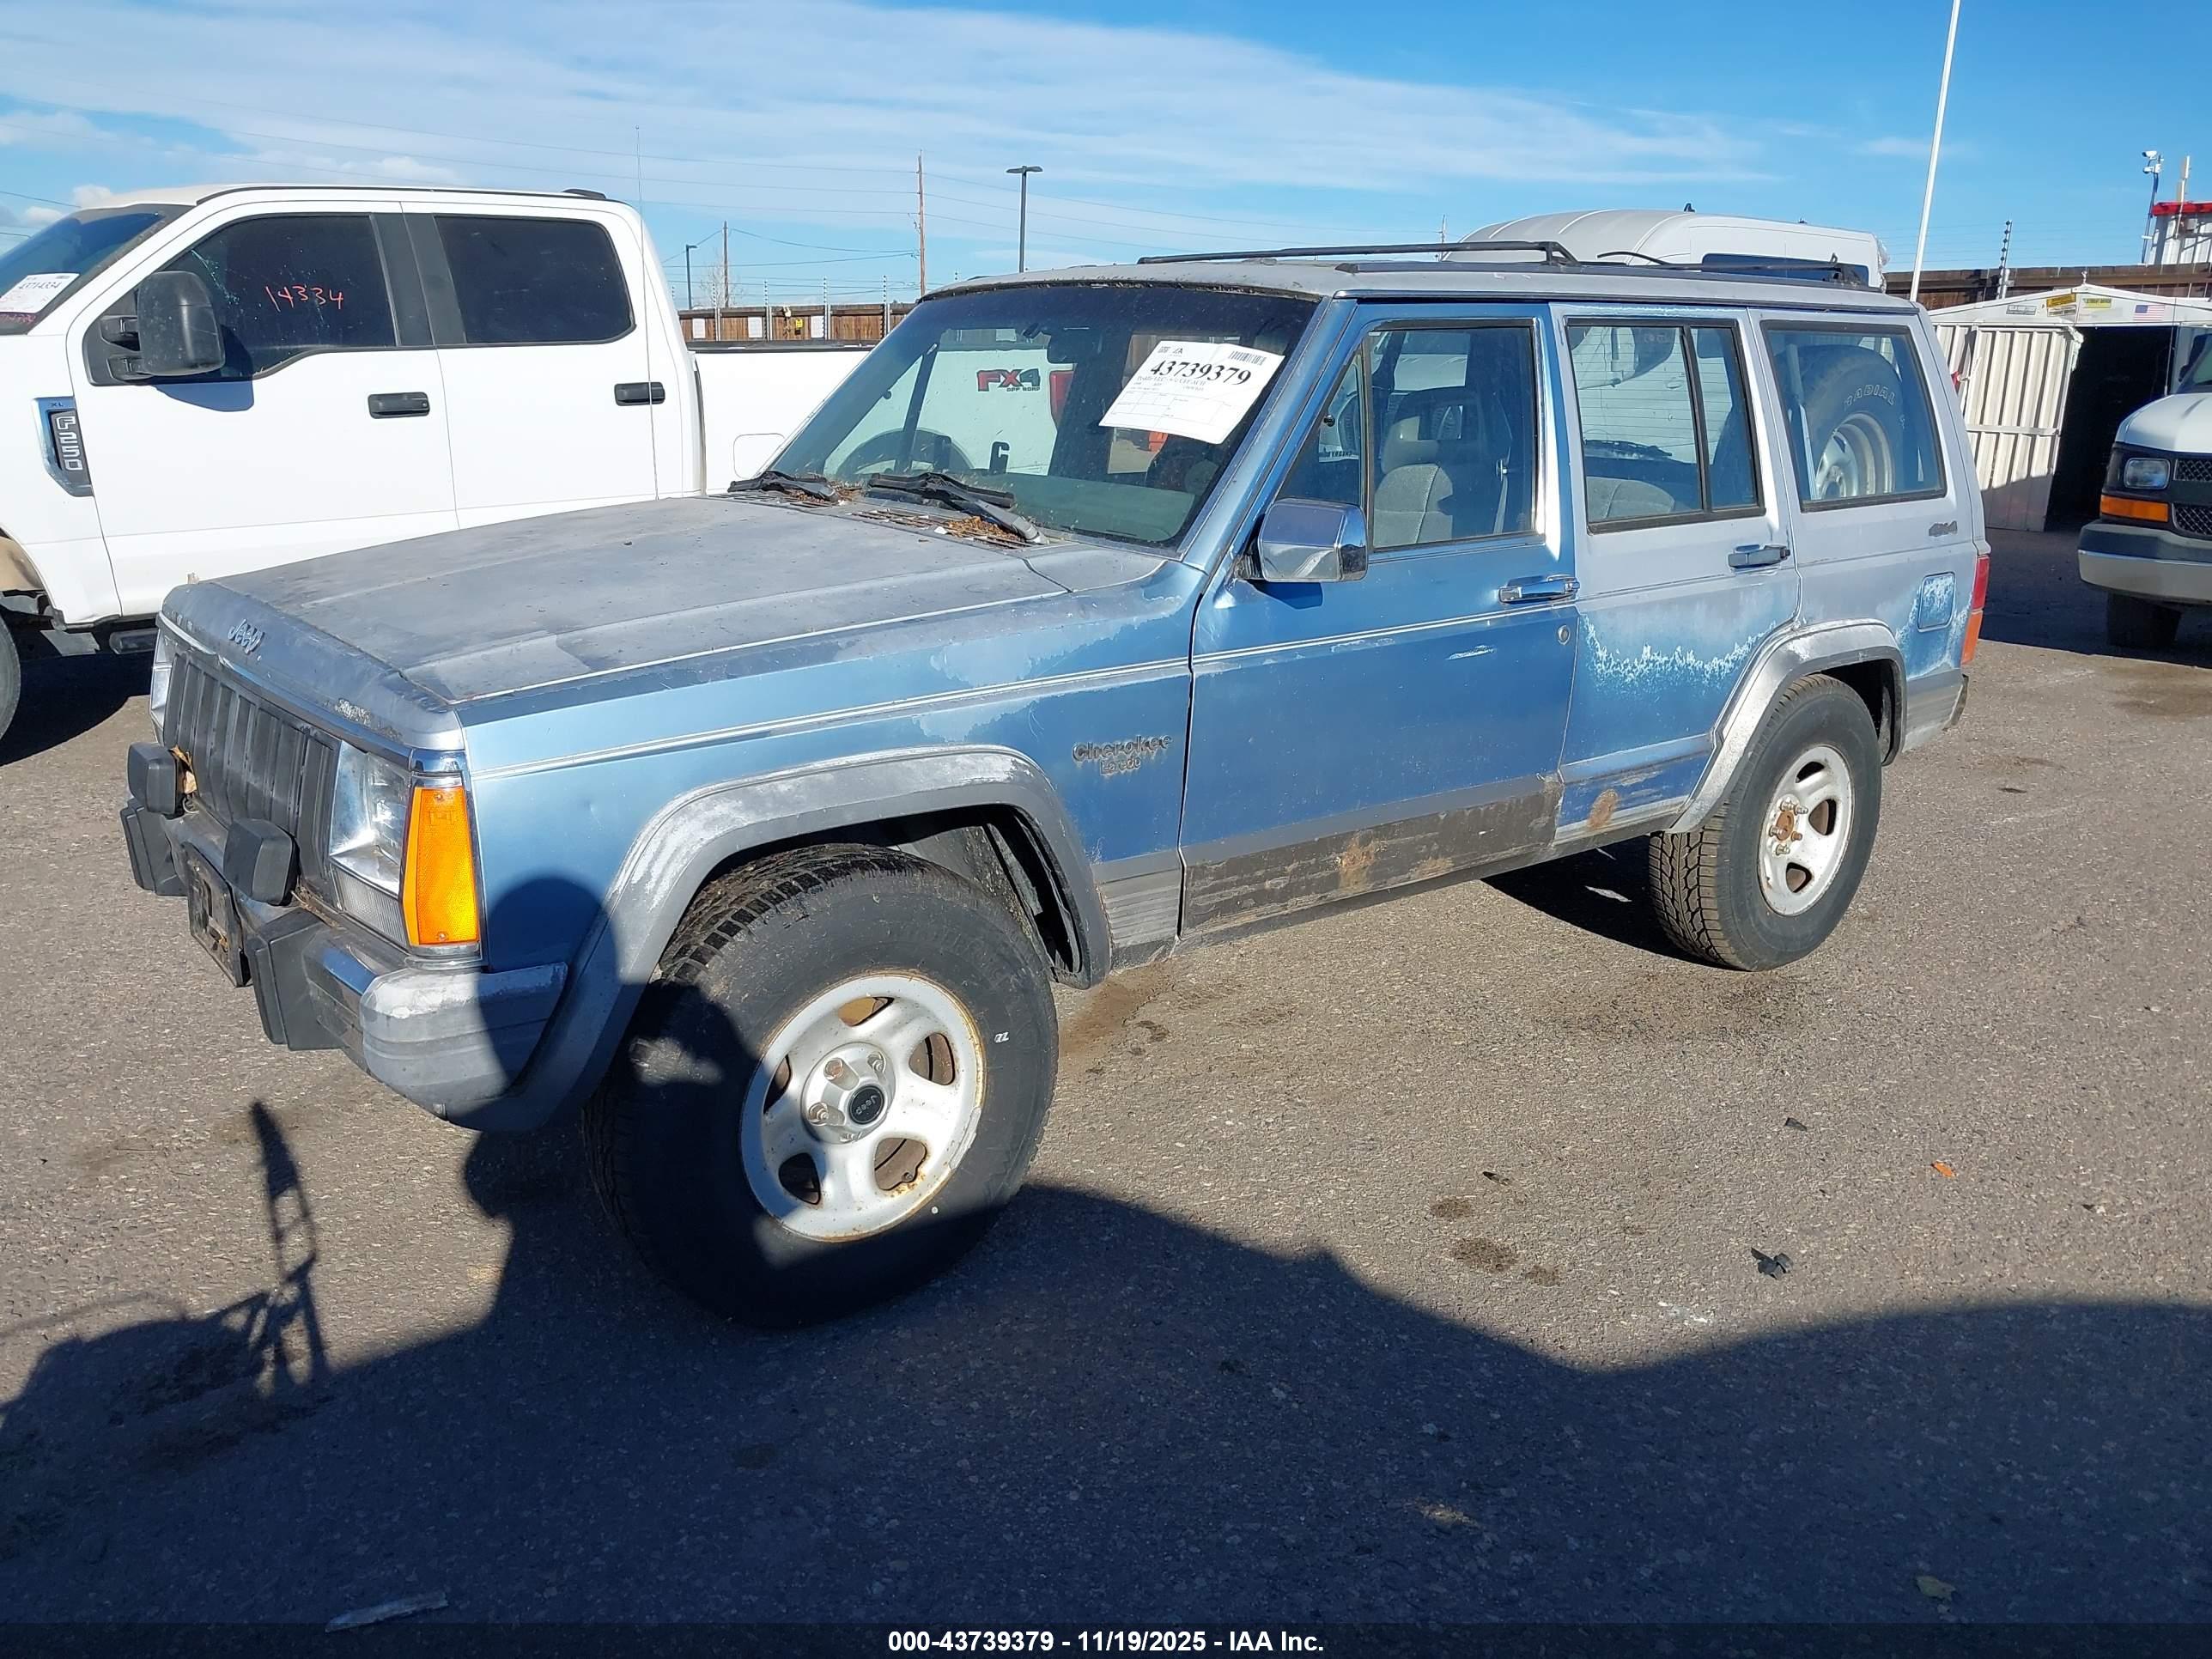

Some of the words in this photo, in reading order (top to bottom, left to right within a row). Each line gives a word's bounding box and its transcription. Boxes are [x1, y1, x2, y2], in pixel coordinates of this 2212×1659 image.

[264, 285, 344, 313] 14334
[976, 368, 1041, 392] FX4
[1150, 359, 1251, 385] 43739379
[228, 618, 265, 655] Jeep
[1072, 734, 1172, 763] Cherokee
[855, 1094, 878, 1115] Jeep
